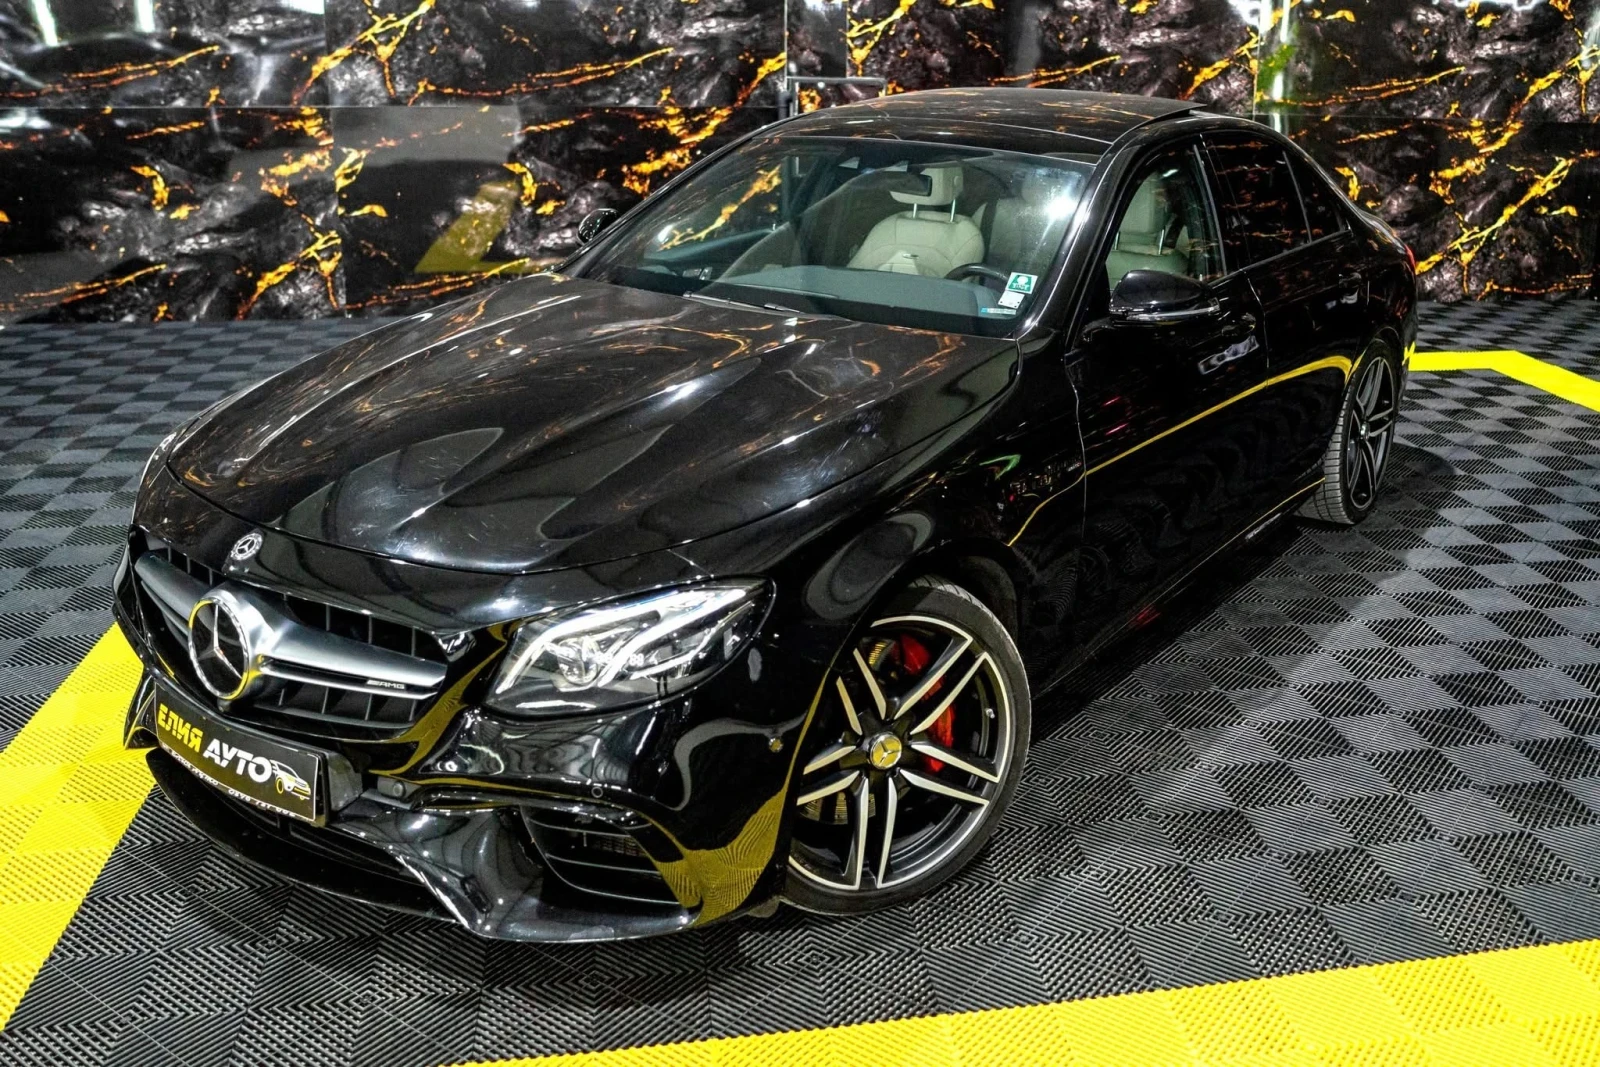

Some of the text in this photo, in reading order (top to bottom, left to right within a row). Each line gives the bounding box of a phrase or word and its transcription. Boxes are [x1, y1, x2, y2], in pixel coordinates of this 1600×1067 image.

[379, 681, 405, 690] AMG
[158, 703, 203, 753] ЕЛИЯ
[203, 738, 272, 783] АУТО
